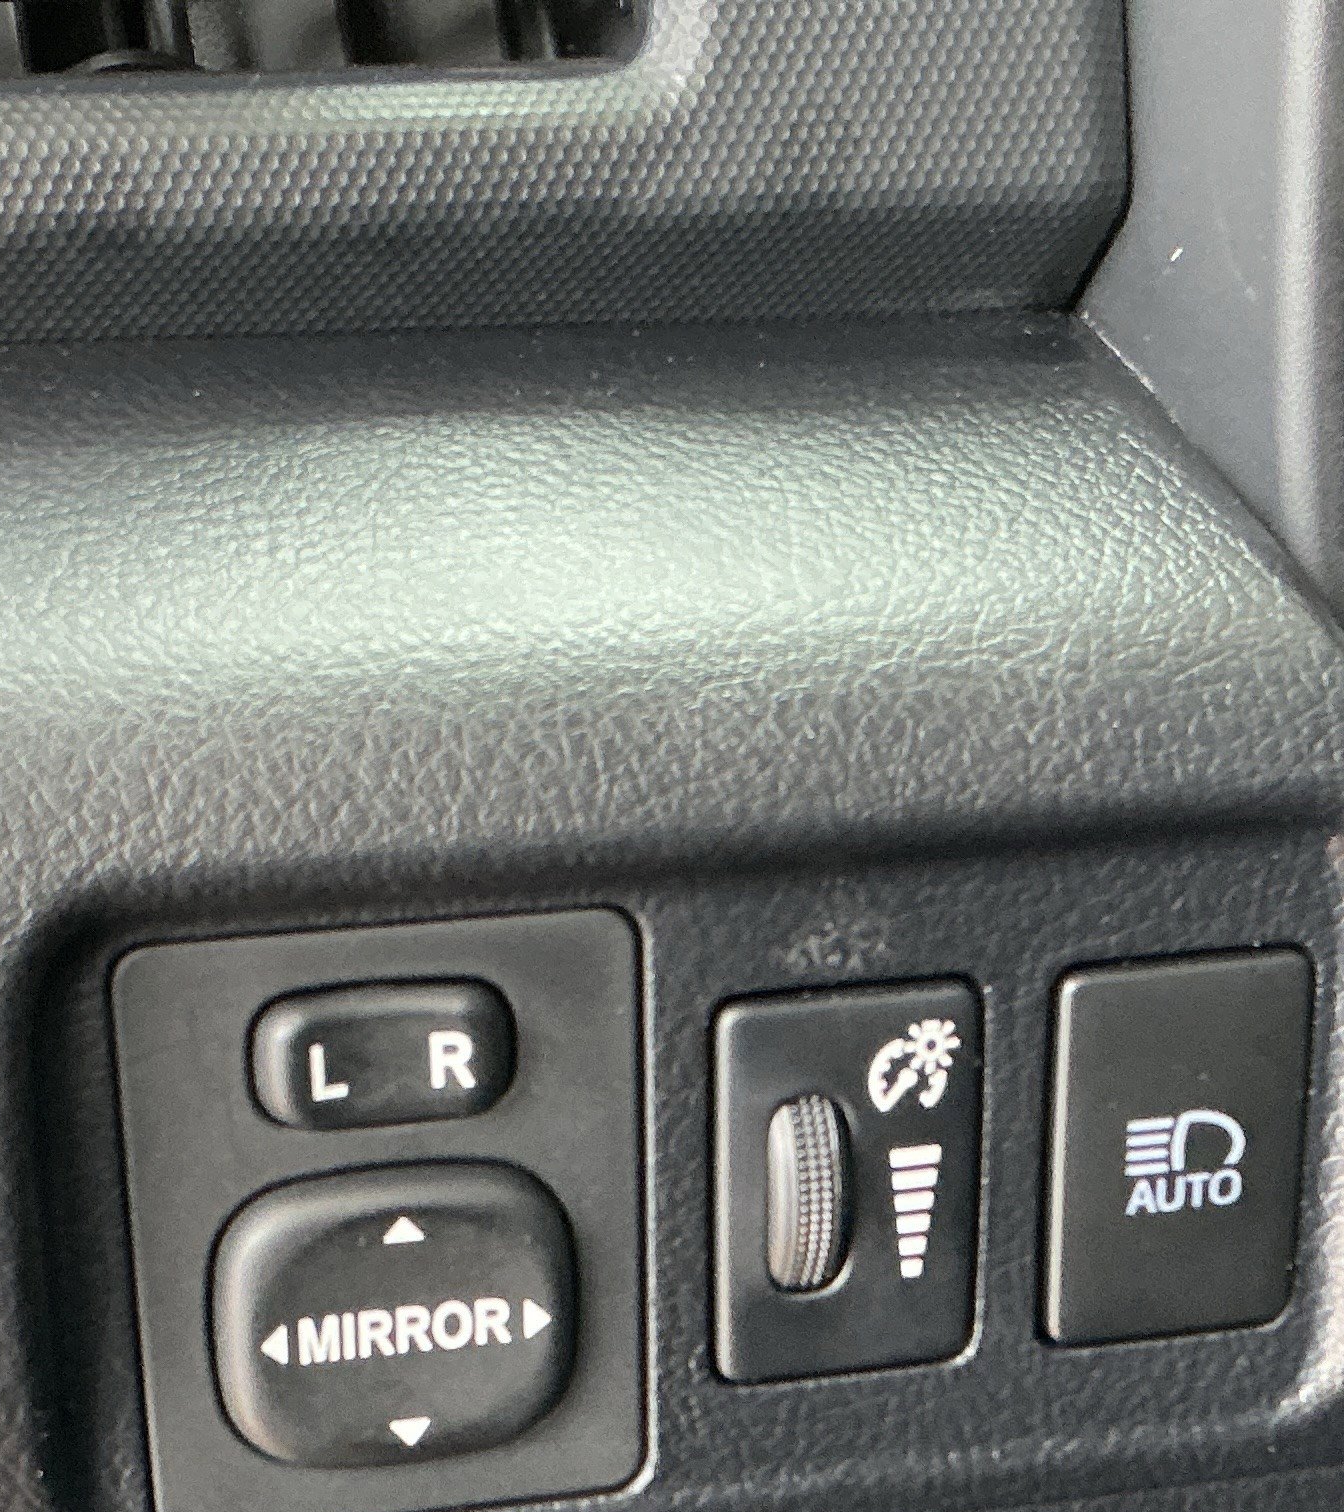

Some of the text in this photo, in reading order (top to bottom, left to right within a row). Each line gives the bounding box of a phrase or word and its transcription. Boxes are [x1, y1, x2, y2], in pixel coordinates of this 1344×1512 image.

[308, 1042, 350, 1103] L
[427, 1029, 477, 1090] R
[1124, 1168, 1243, 1217] AUTO
[297, 1296, 513, 1367] MIRROR
